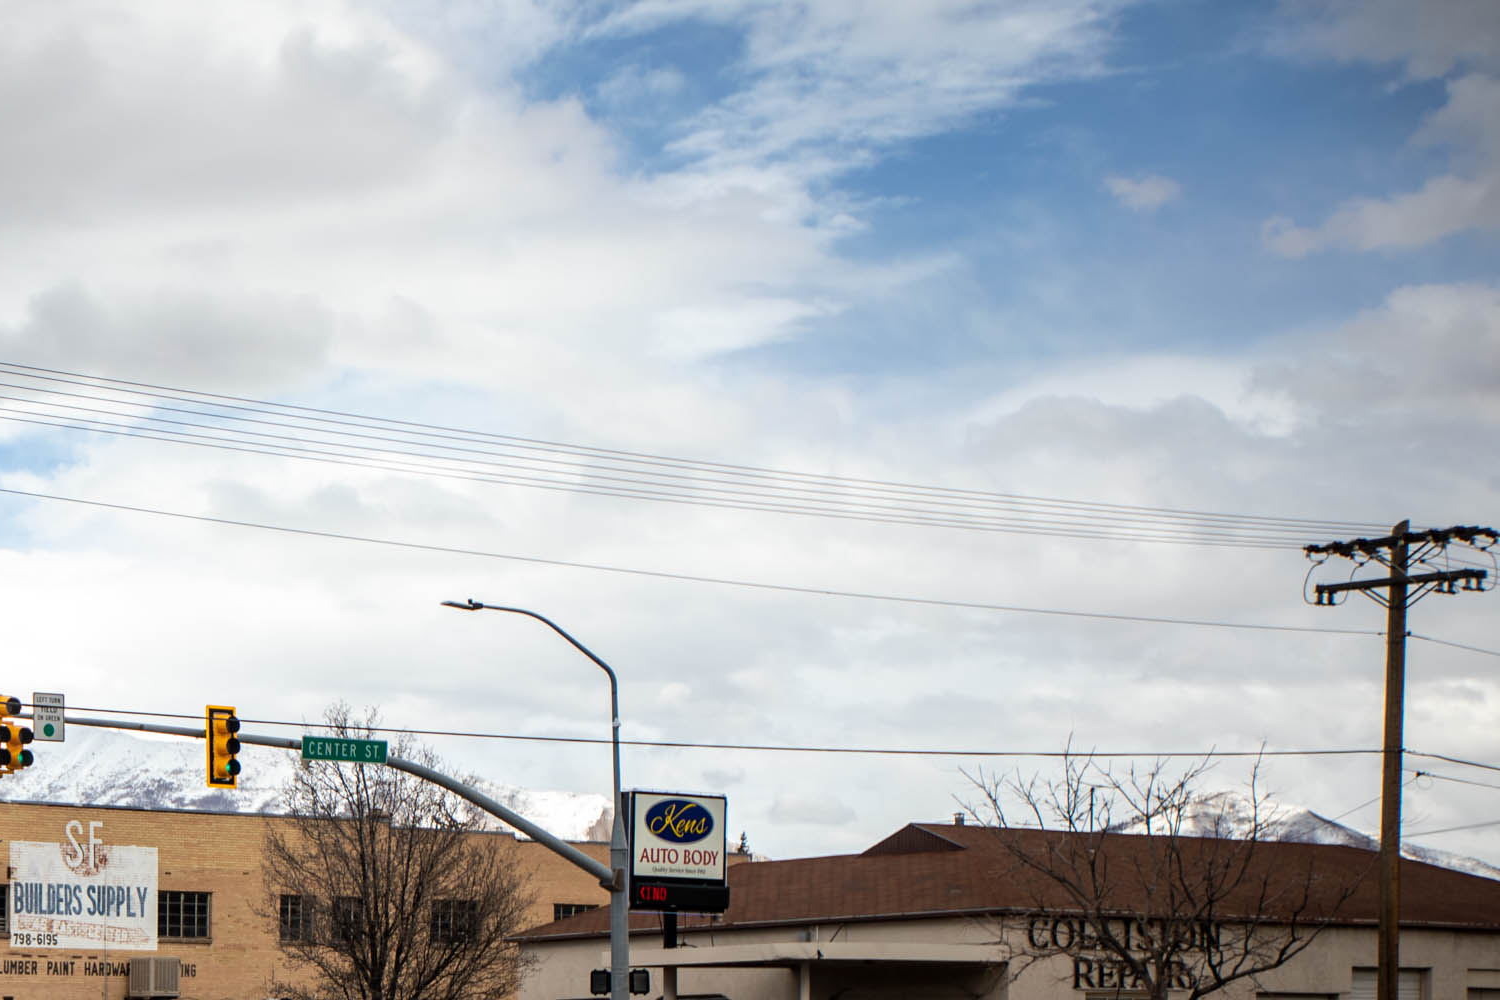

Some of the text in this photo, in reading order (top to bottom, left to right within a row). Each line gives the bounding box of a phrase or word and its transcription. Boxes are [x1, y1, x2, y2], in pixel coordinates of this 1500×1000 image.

[308, 741, 357, 758] CENTER
[650, 803, 709, 838] Kens
[639, 847, 719, 867] AUTO BODY
[13, 881, 148, 918] BUILDERS SUPPLY
[13, 932, 58, 946] 798-6195
[1027, 918, 1220, 950] COLISION
[47, 961, 75, 976] PAINT
[181, 963, 197, 978] ING
[1073, 958, 1193, 989] REPAR
